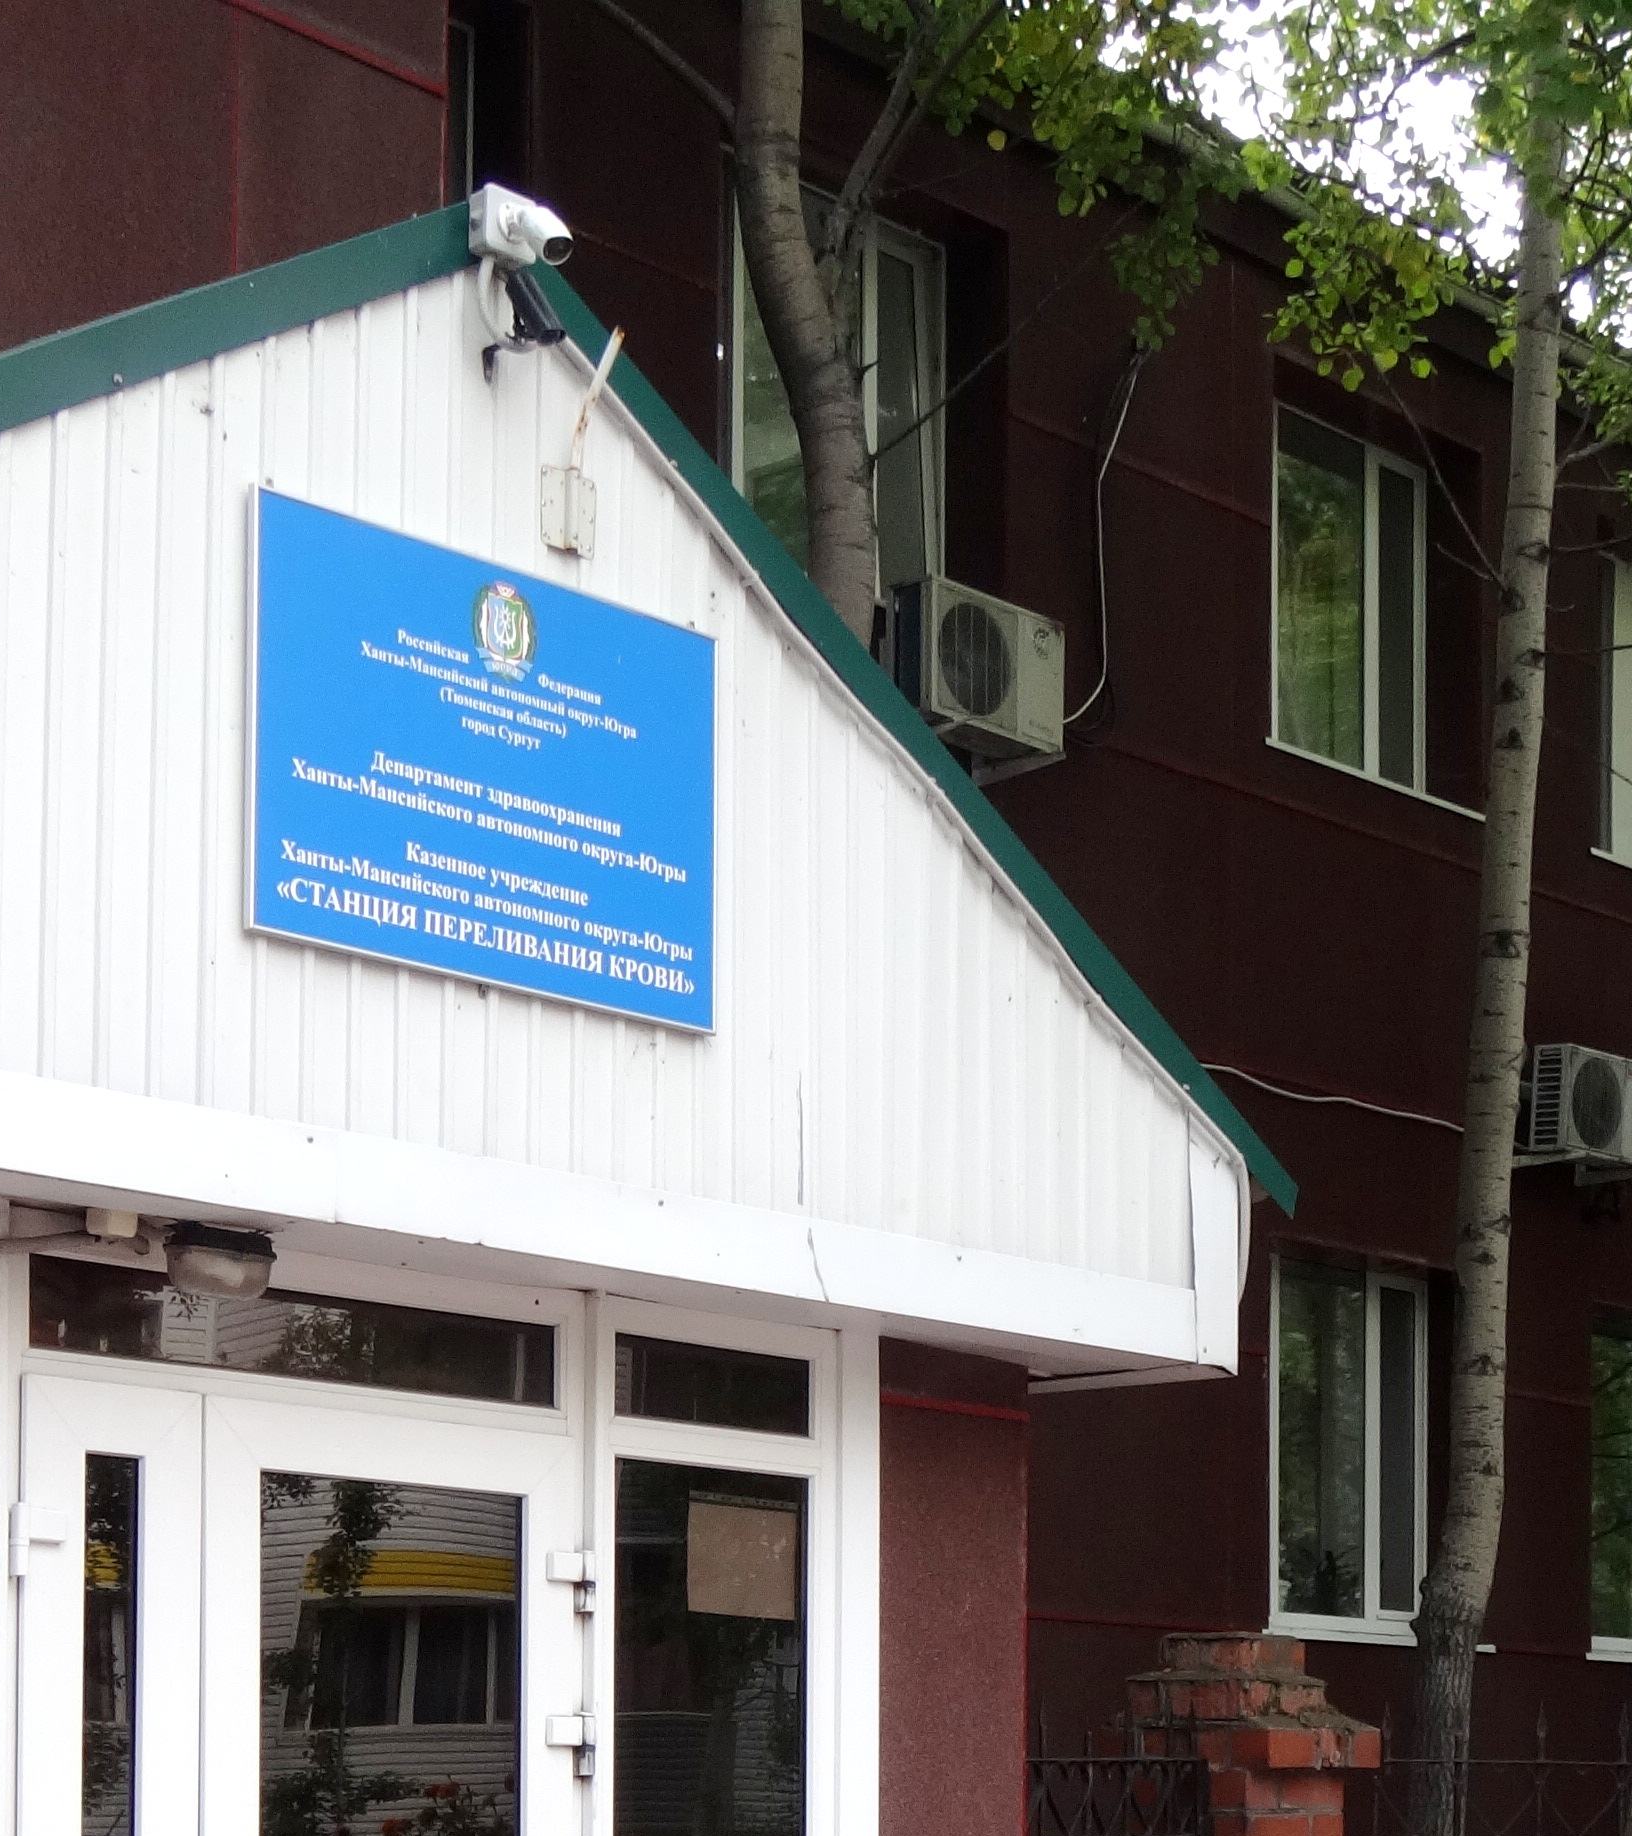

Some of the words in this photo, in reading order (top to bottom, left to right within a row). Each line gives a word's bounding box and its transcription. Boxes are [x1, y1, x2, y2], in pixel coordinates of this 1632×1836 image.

[397, 629, 469, 664] Российская
[361, 641, 489, 692] Ханты-Мансийский
[491, 685, 565, 717] автономный
[567, 708, 637, 739] округ-Югра
[440, 686, 514, 721] (Тюменская
[516, 710, 567, 738] область)
[538, 672, 601, 705] Федерация
[462, 716, 495, 739] город
[498, 725, 541, 751] Сургут
[292, 758, 472, 826] Ханты-Мансийского
[477, 813, 579, 853] автономного
[582, 842, 687, 884] округа-Югры
[371, 751, 483, 799] Департамент
[487, 789, 622, 838] здравоохранения
[281, 839, 470, 904] Ханты-Мансийского
[474, 894, 579, 933] автономного
[584, 923, 693, 962] округа-Югры
[406, 842, 486, 880] Казенное
[490, 866, 589, 908] учреждение
[276, 877, 416, 929] «СТАНЦИЯ
[424, 909, 603, 976] ПЕРЕЛИВАНИЯ
[609, 956, 695, 995] КРОВИ»
